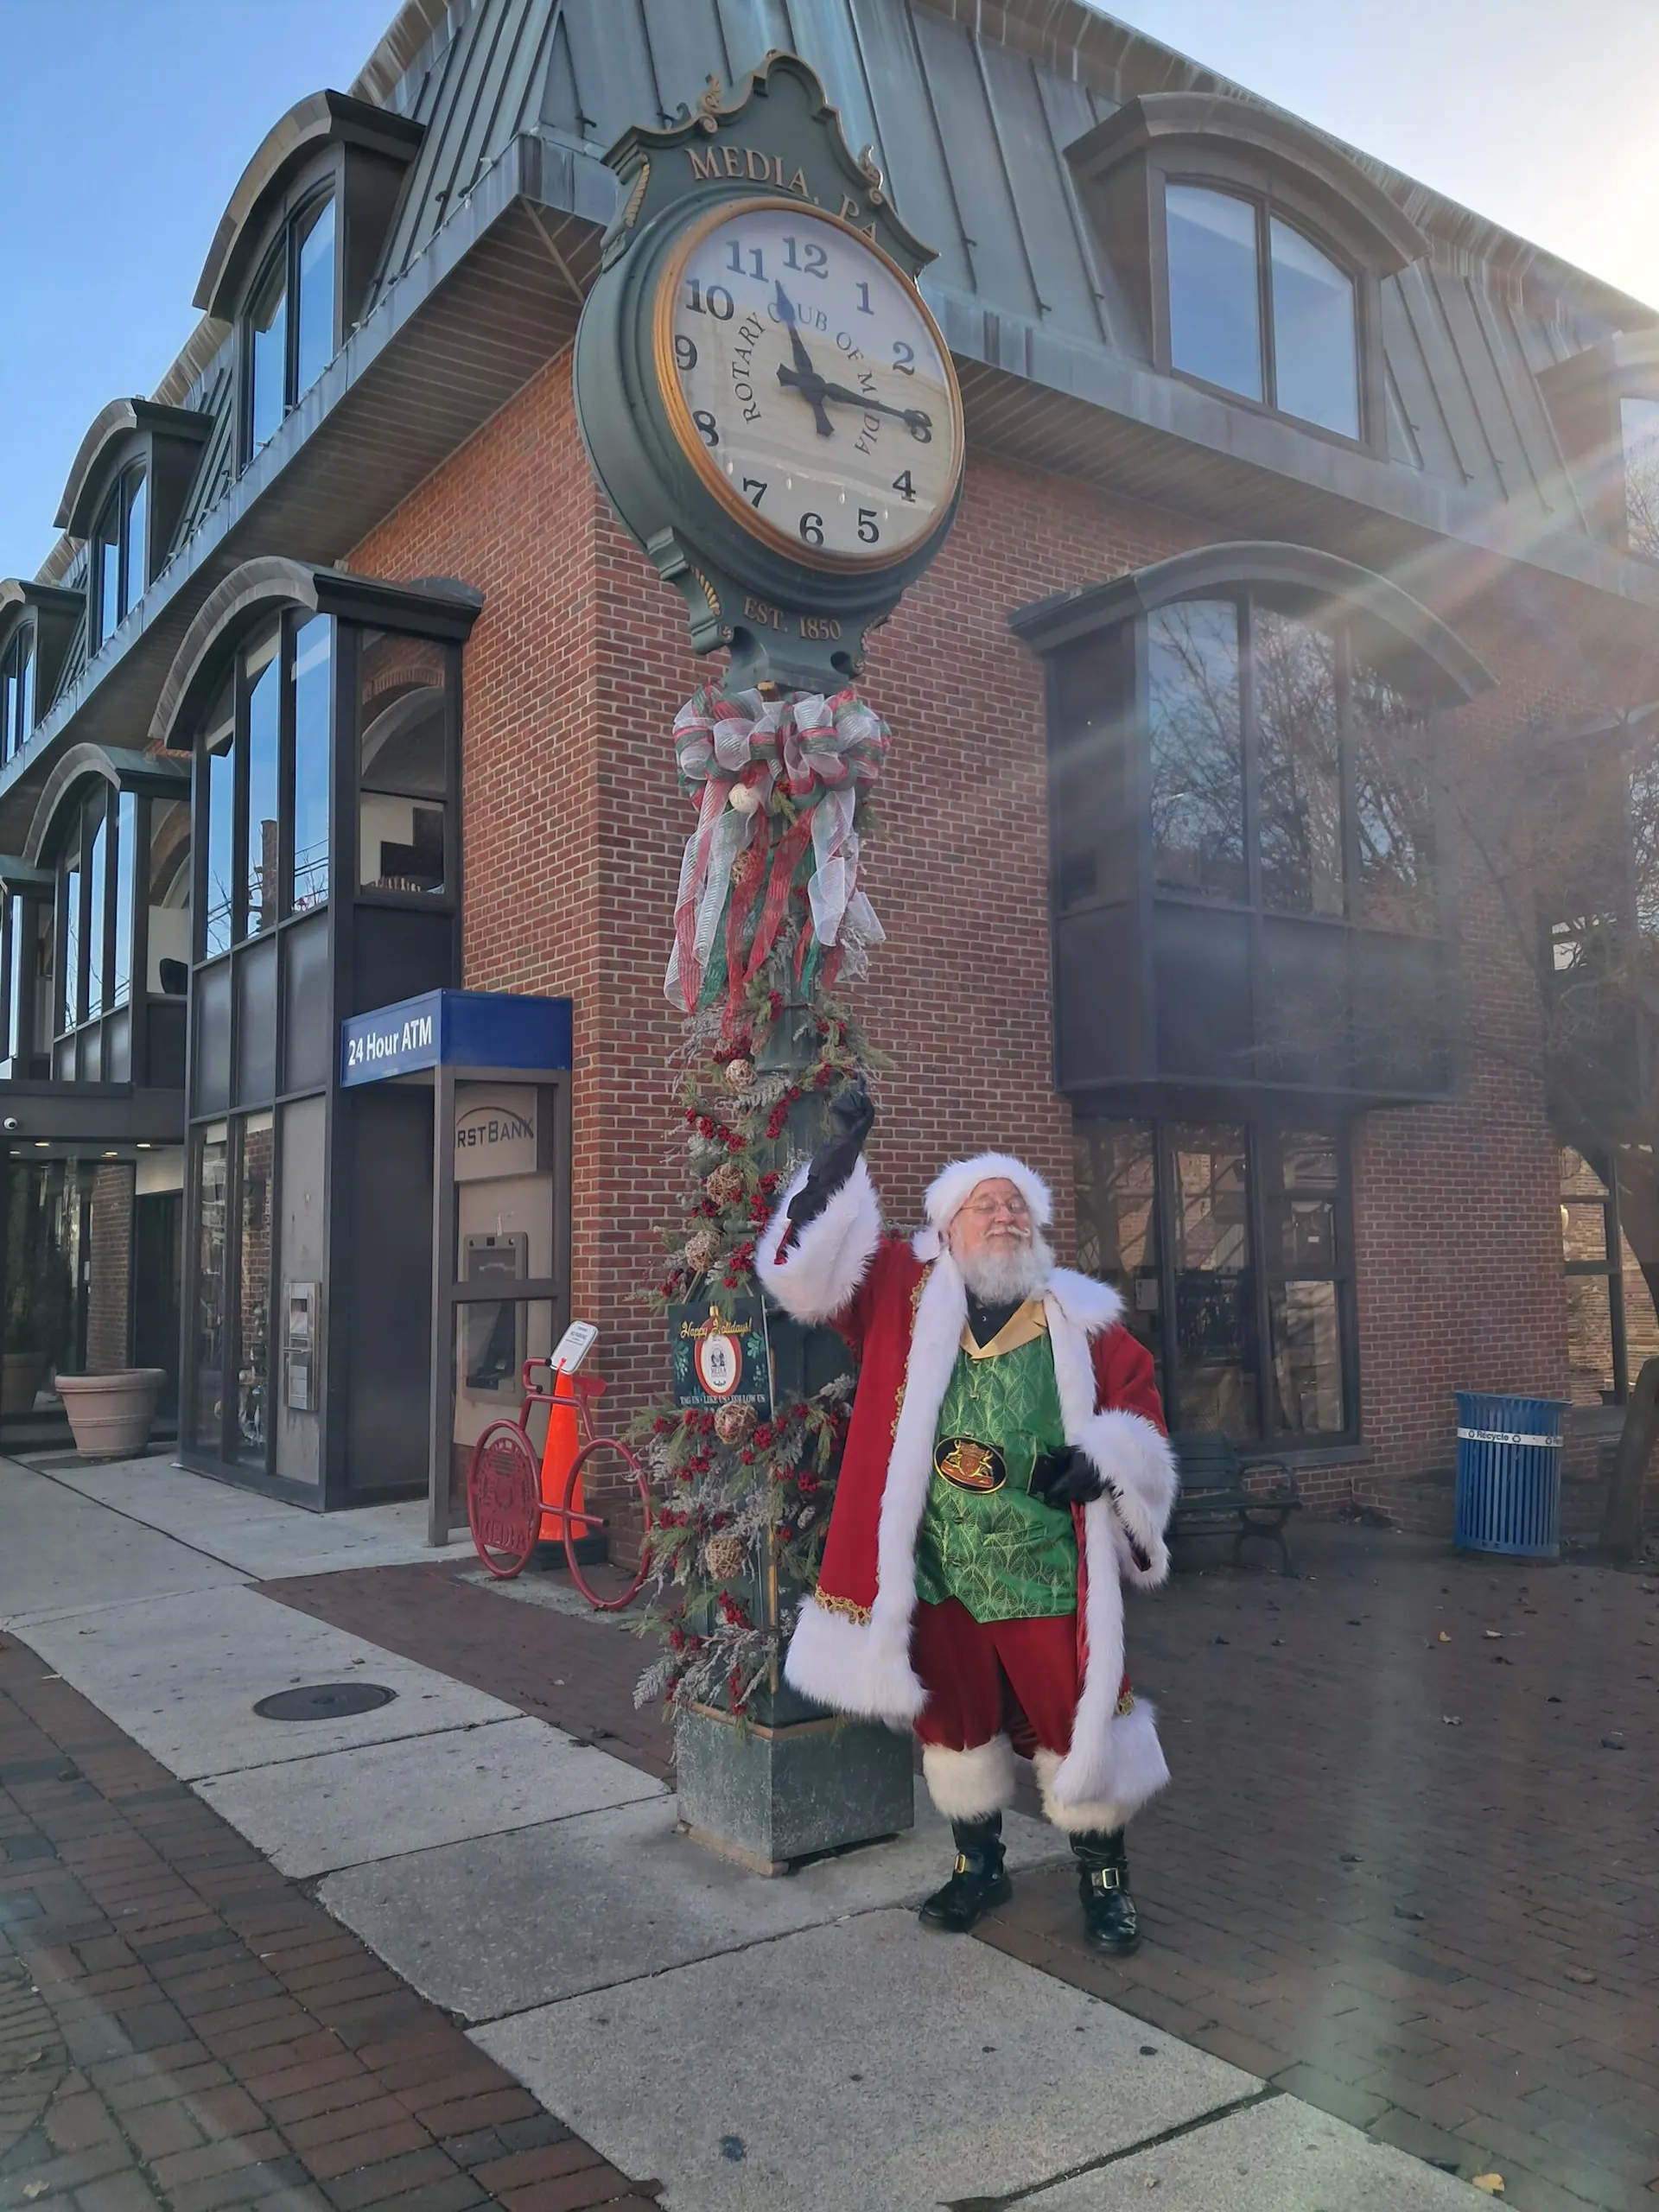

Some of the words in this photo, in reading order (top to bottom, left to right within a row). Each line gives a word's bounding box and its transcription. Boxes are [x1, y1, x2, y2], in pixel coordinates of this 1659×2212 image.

[726, 239, 769, 283] 11
[783, 237, 828, 278] 12
[685, 278, 734, 321] 10
[855, 282, 874, 315] 1
[675, 334, 697, 371] 9
[893, 341, 914, 375] 2
[732, 312, 766, 423] ROTARY
[767, 302, 827, 331] CUB
[836, 332, 864, 362] OF
[855, 372, 880, 455] MDIA
[693, 410, 719, 447] 8
[743, 477, 767, 508] 7
[893, 470, 916, 503] 4
[799, 512, 823, 547] 6
[857, 508, 880, 543] 5
[743, 597, 788, 633] EST.
[798, 616, 842, 640] 1850
[348, 1039, 364, 1065] 24
[366, 1029, 399, 1061] Hour
[401, 1015, 432, 1052] ATM
[457, 1116, 534, 1148] RSTBANK
[680, 1321, 708, 1340] Happy
[1477, 1431, 1509, 1442] Recycle
